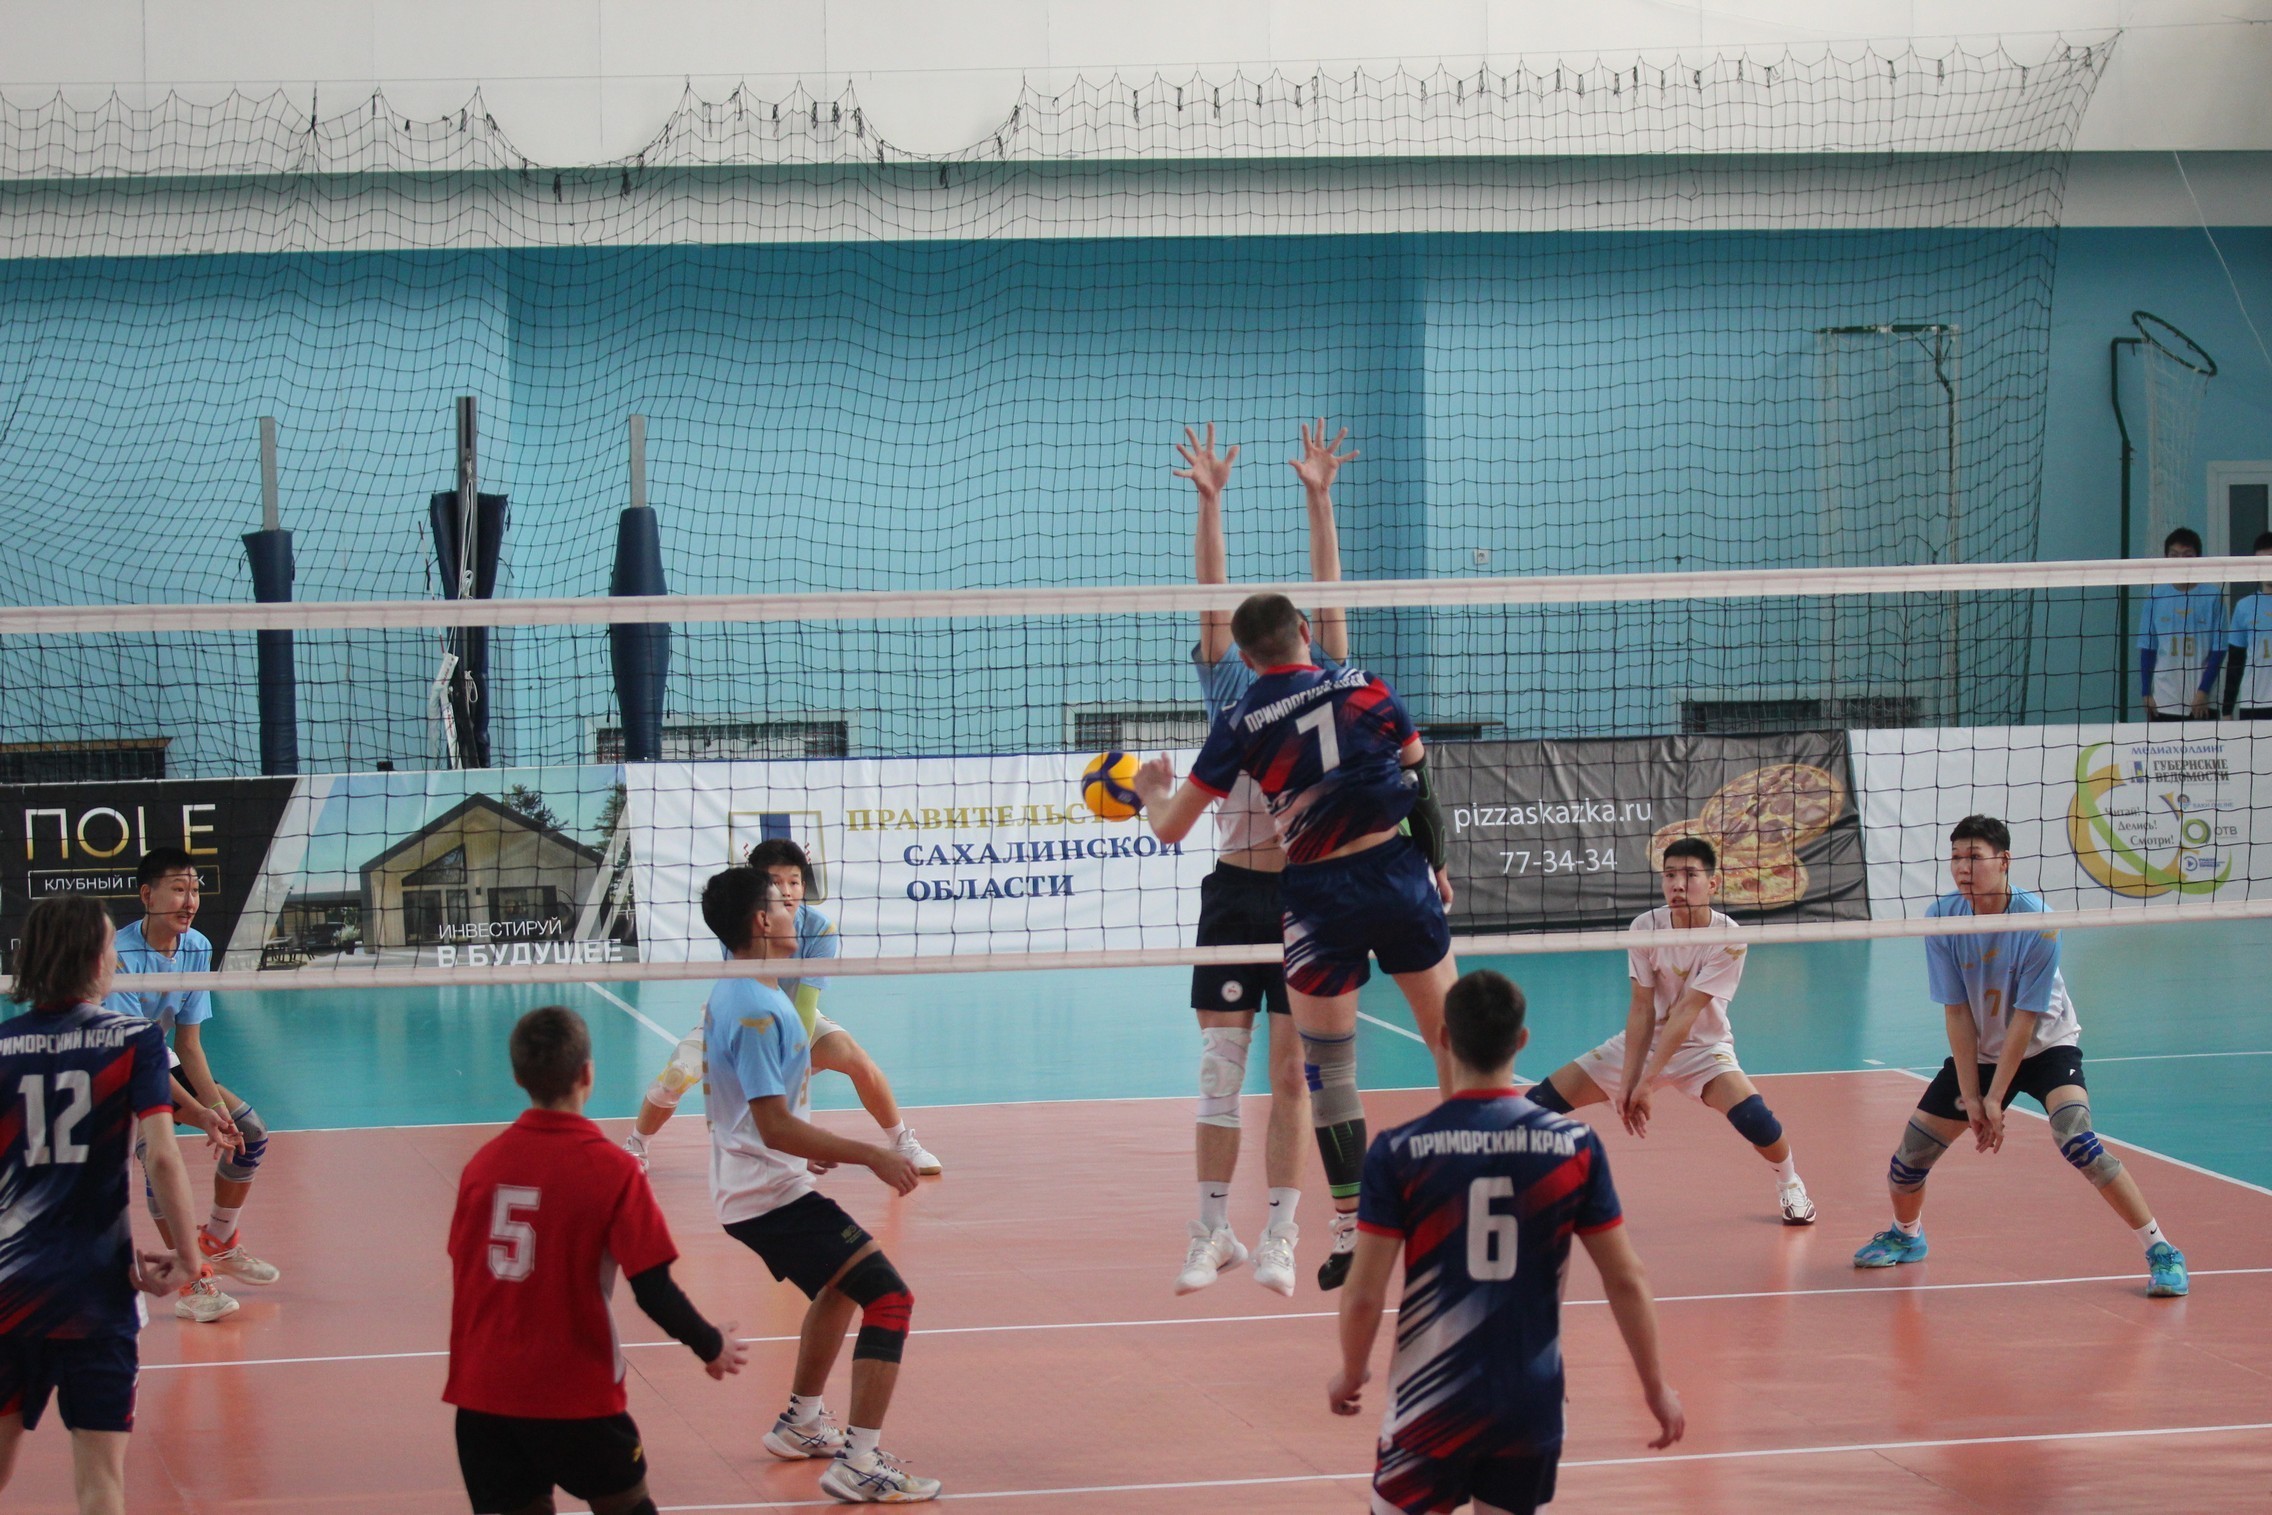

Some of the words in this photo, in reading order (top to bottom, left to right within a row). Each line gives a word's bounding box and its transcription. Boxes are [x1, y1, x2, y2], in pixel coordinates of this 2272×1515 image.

[1295, 700, 1341, 774] 7
[2153, 759, 2228, 771] ГУБЕРНСКИЕ
[846, 800, 1149, 832] ПРАВИТЕЛЬС
[1453, 798, 1651, 834] pizzaskazka.ru
[2118, 820, 2158, 831] Делись!
[2130, 834, 2174, 847] Смотри!
[1500, 848, 1617, 874] 77-34-34
[45, 874, 123, 890] КЛУБНЫЙ
[906, 874, 1075, 902] ОБЛАСТИ
[439, 917, 562, 939] ИНВЕСТИРУЙ
[438, 945, 458, 968] В
[468, 938, 623, 967] БУДУЩЕЕ
[0, 1027, 83, 1056] ИМОРСКИЙ
[17, 1069, 92, 1168] 12
[1410, 1125, 1528, 1159] ПРИМОРСКИЙ
[488, 1183, 541, 1282] 5
[1466, 1176, 1518, 1281] 6
